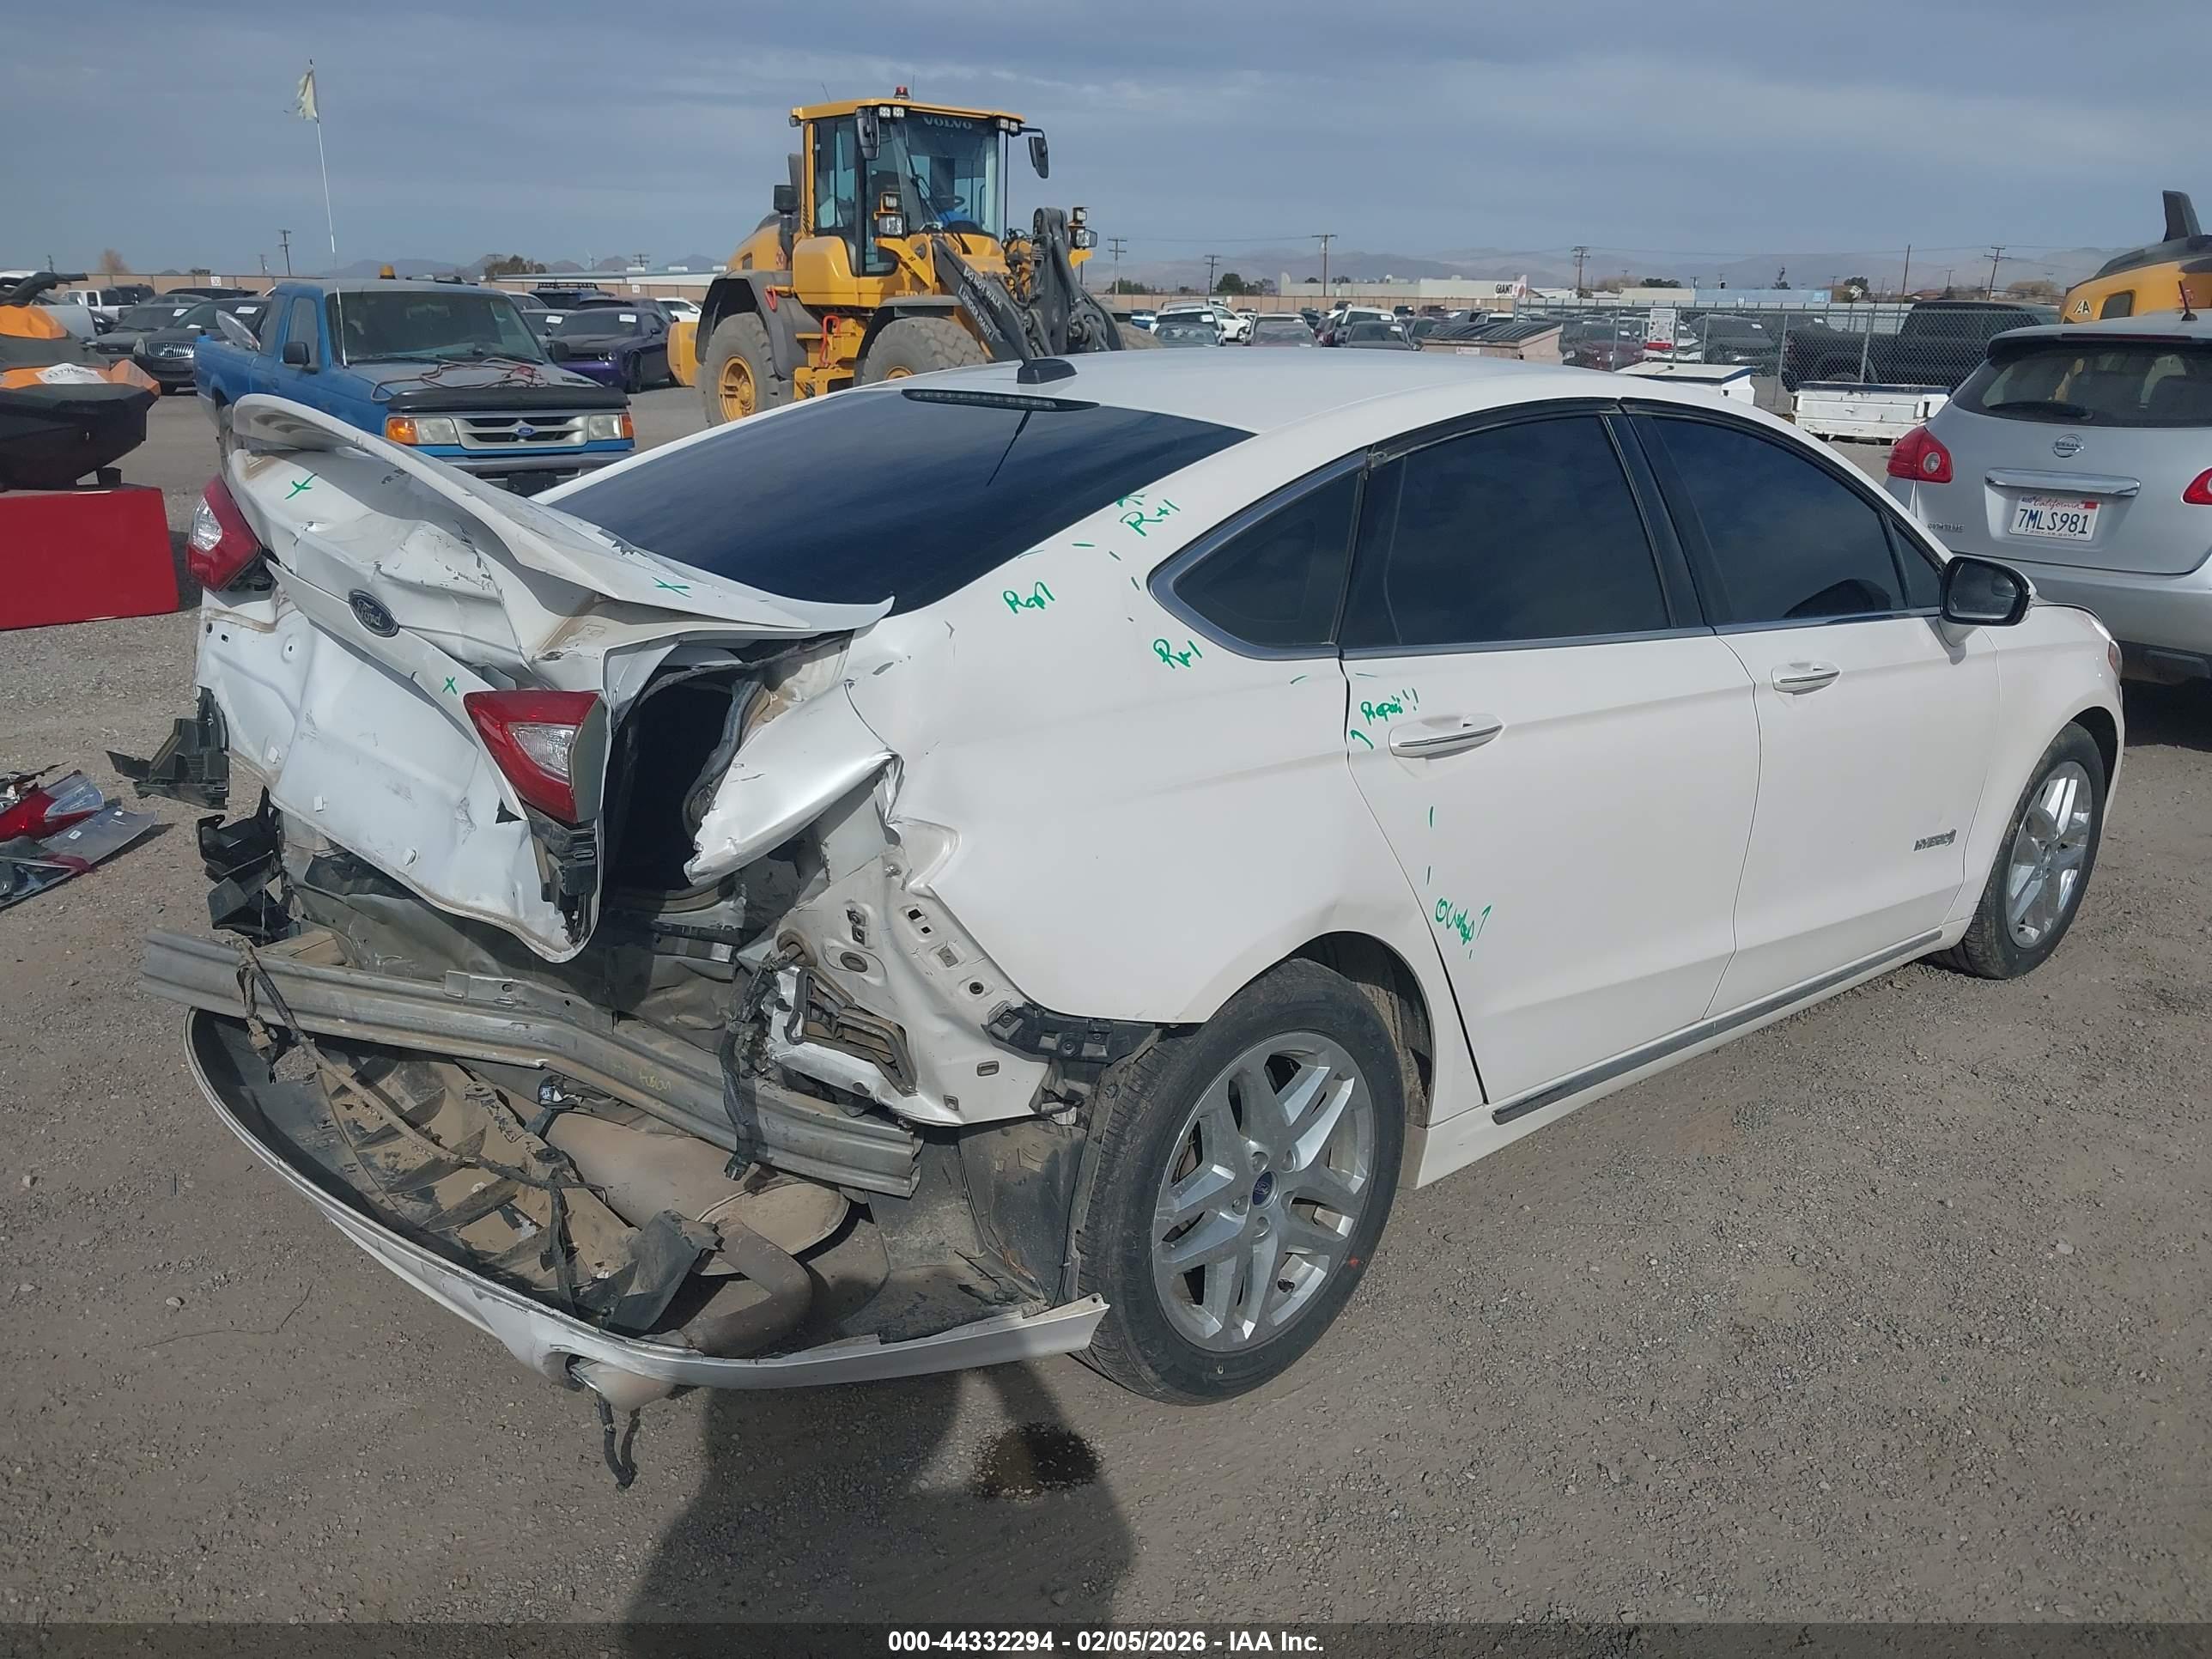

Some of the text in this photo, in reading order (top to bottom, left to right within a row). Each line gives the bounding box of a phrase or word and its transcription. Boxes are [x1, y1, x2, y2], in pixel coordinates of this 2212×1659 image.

[922, 116, 973, 131] VOLVO
[973, 276, 987, 293] NOT
[986, 289, 1003, 309] WALK
[1496, 283, 1513, 295] GIANT
[2018, 508, 2088, 534] 7MLS981
